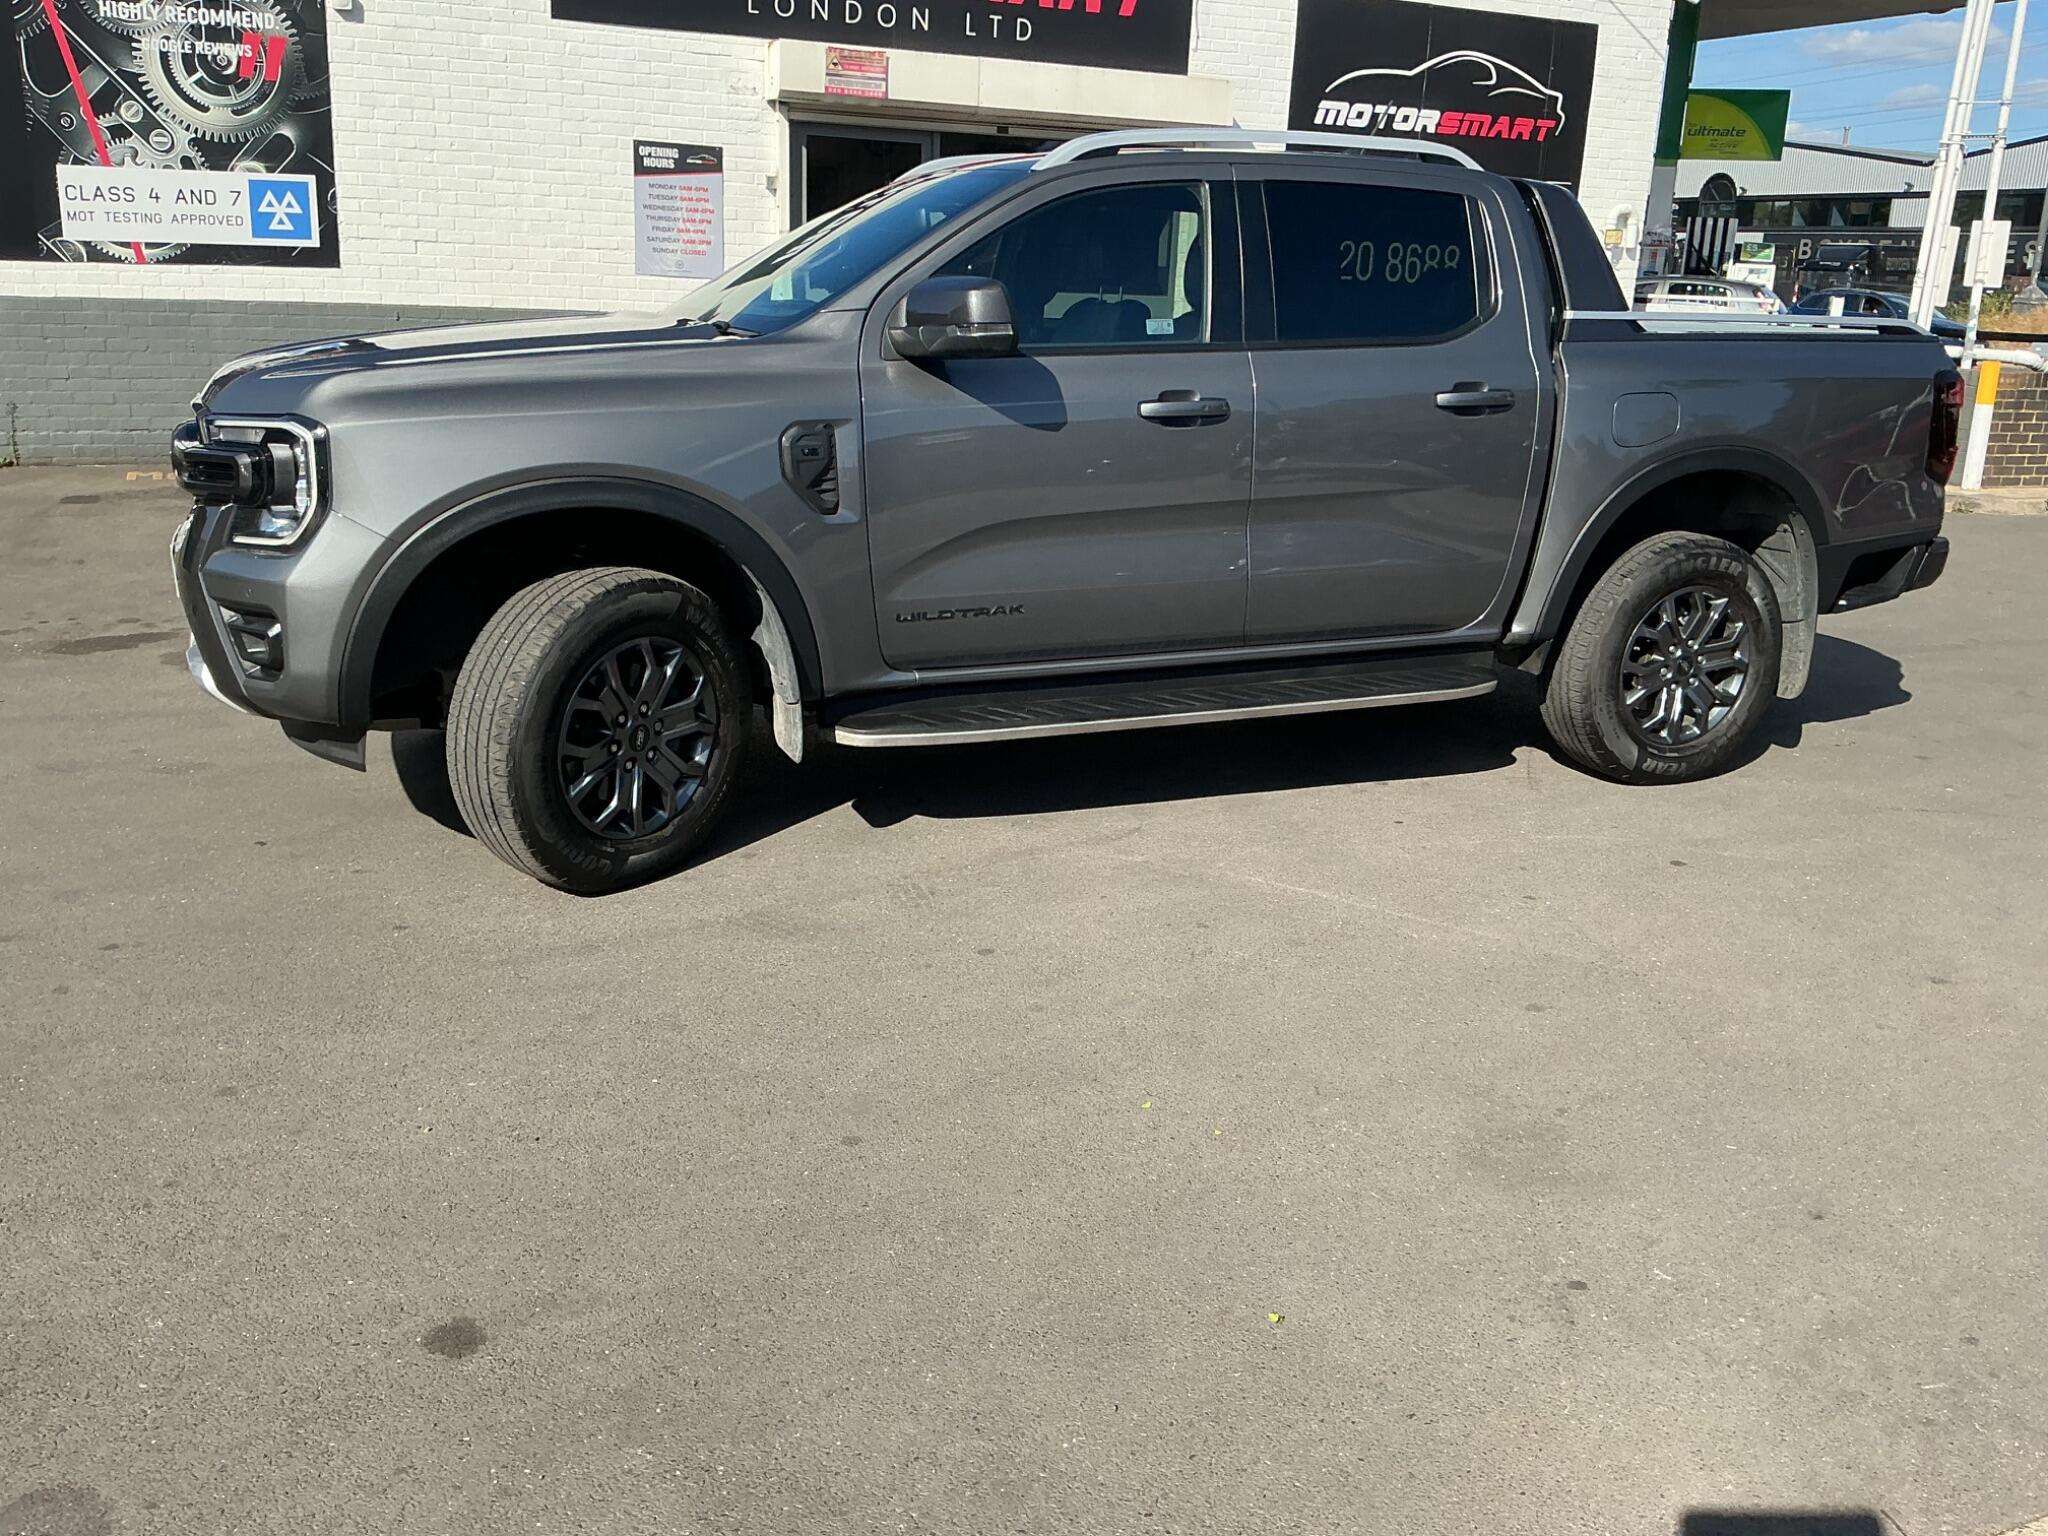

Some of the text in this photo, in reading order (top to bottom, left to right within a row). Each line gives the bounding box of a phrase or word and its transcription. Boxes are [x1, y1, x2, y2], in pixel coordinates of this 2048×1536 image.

[99, 0, 279, 30] HIGHLY RECOMMEND.
[747, 0, 1032, 41] LONDON LTD
[194, 41, 252, 58] REVIEWS
[1313, 100, 1556, 142] MOTORSMART
[638, 145, 679, 159] OPENING
[643, 157, 675, 169] HOURS
[648, 183, 677, 191] MONDAY
[64, 184, 242, 206] CLASS 4 AND 7
[648, 193, 679, 201] TUESDAY
[643, 204, 684, 212] WEDNESDAY
[66, 210, 244, 226] MOT TESTING APPROVED
[646, 214, 680, 223] THURSDAY
[647, 236, 680, 244] SATURDAY
[680, 248, 707, 256] CLOSED
[895, 604, 1025, 623] WILDTRAK
